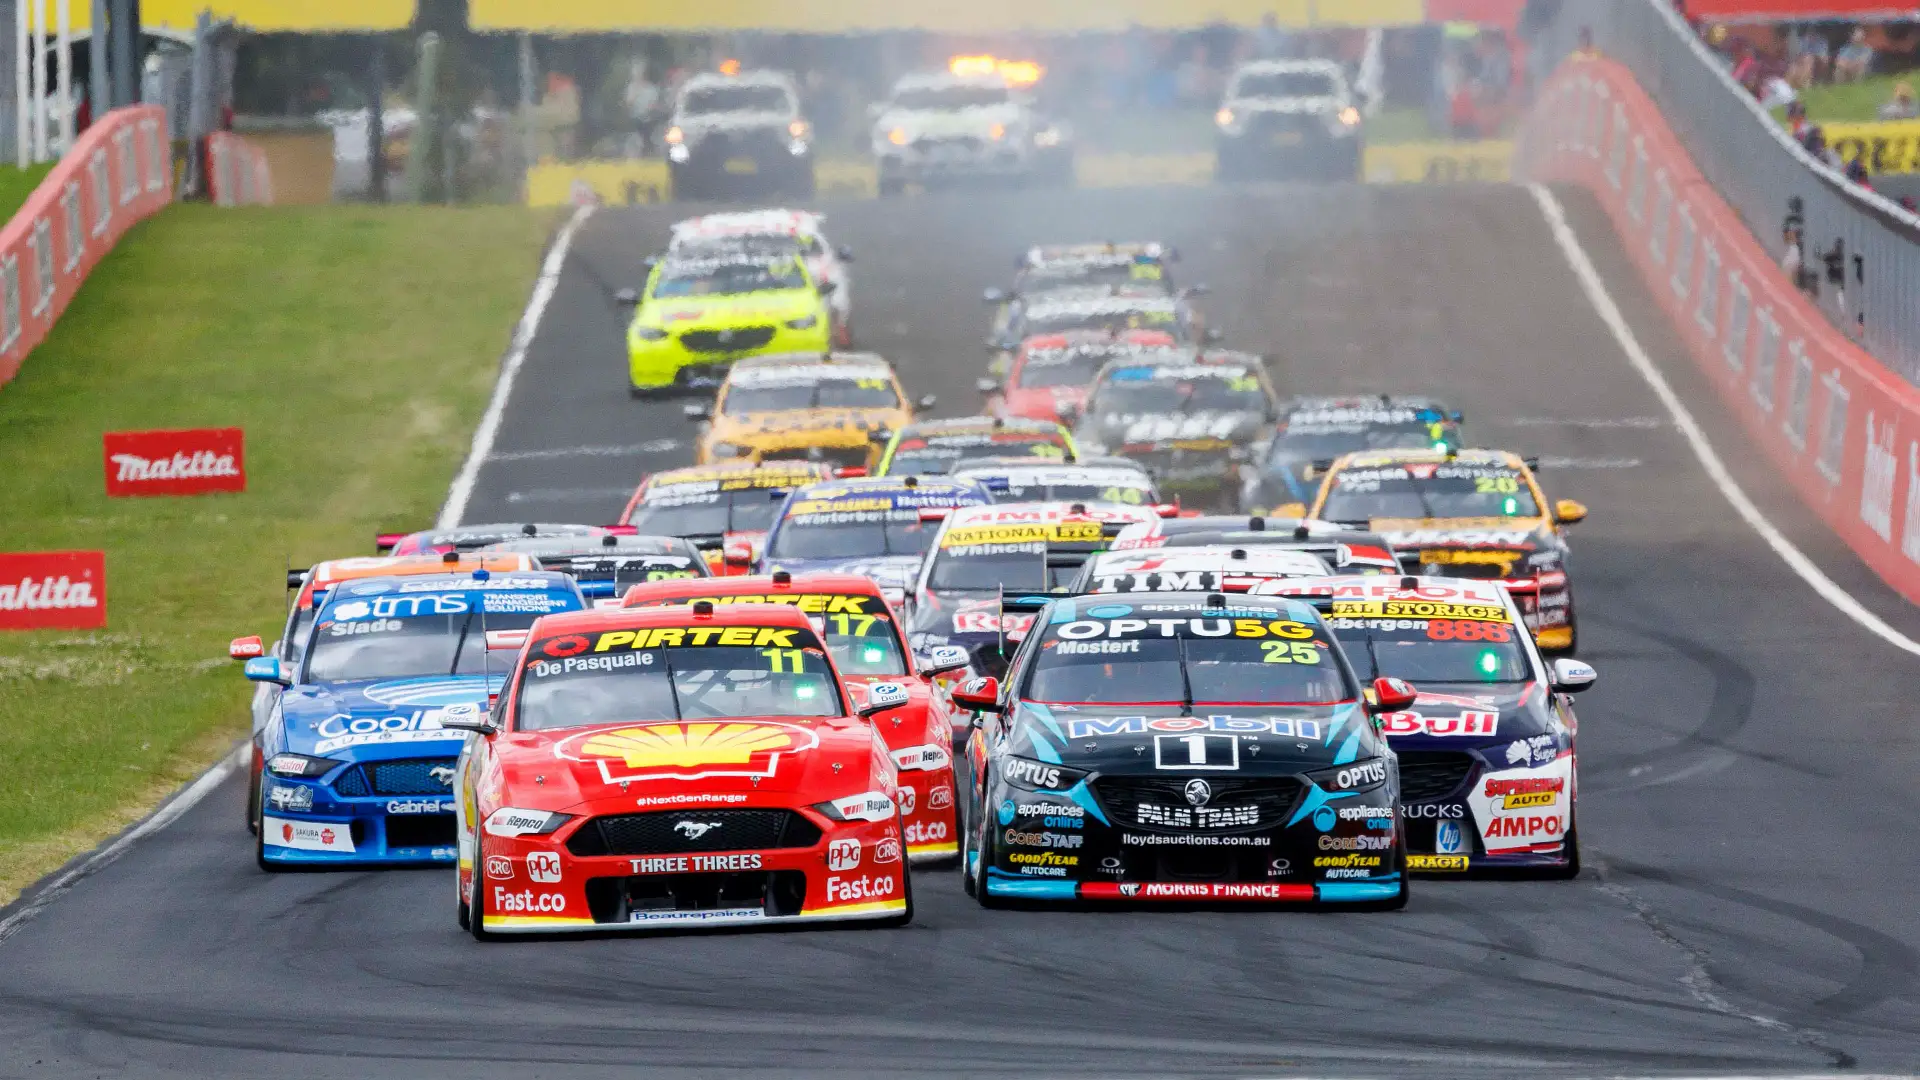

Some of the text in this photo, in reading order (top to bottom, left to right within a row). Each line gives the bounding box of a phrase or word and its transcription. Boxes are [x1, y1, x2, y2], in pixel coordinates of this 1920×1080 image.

[949, 527, 1050, 542] NATIONAL
[483, 593, 548, 601] TRANSPORT
[483, 599, 567, 607] MANAGEMENT
[372, 594, 468, 617] tms
[484, 604, 552, 613] SOLUTIONS
[1386, 603, 1504, 619] STORAGE
[330, 618, 403, 636] Slade
[830, 613, 877, 637] 17
[1427, 619, 1510, 640] 888
[594, 626, 800, 652] PIRTEK
[1056, 639, 1140, 655] Mostert
[1260, 641, 1321, 664] 25
[535, 651, 653, 678] De Pasquale
[762, 648, 804, 674] 11
[881, 693, 907, 703] Doric
[412, 731, 465, 739] PAR
[1068, 715, 1320, 740] Mobil
[1006, 759, 1061, 788] OPTUS
[1337, 762, 1386, 789] OPTUS
[636, 794, 748, 806] #NextGenRanger
[866, 800, 890, 811] Repco
[1510, 793, 1551, 805] AUTO
[387, 800, 440, 814] Gabriel
[1017, 803, 1085, 818] appliances
[1339, 805, 1394, 820] appliances
[1400, 804, 1464, 818] RUCKS
[506, 815, 543, 829] Repco
[1044, 816, 1085, 829] online
[1137, 803, 1260, 828] PALM TRANS
[295, 828, 319, 837] SAKURA
[1123, 833, 1271, 847] lloydsauctions.com.au
[629, 854, 762, 873] THREE THREES
[1009, 851, 1079, 866] GOODYEAR
[1314, 853, 1381, 868] GOODYEAR
[488, 861, 511, 874] CRC
[1021, 866, 1067, 877] AUTOCARE
[1326, 868, 1371, 878] AUTOCARE
[827, 874, 894, 902] Fast.co
[1146, 884, 1209, 896] MORRIS
[1213, 884, 1280, 898] FINANCE
[494, 886, 566, 912] Fast.co
[635, 909, 760, 921] Beaurepaires
